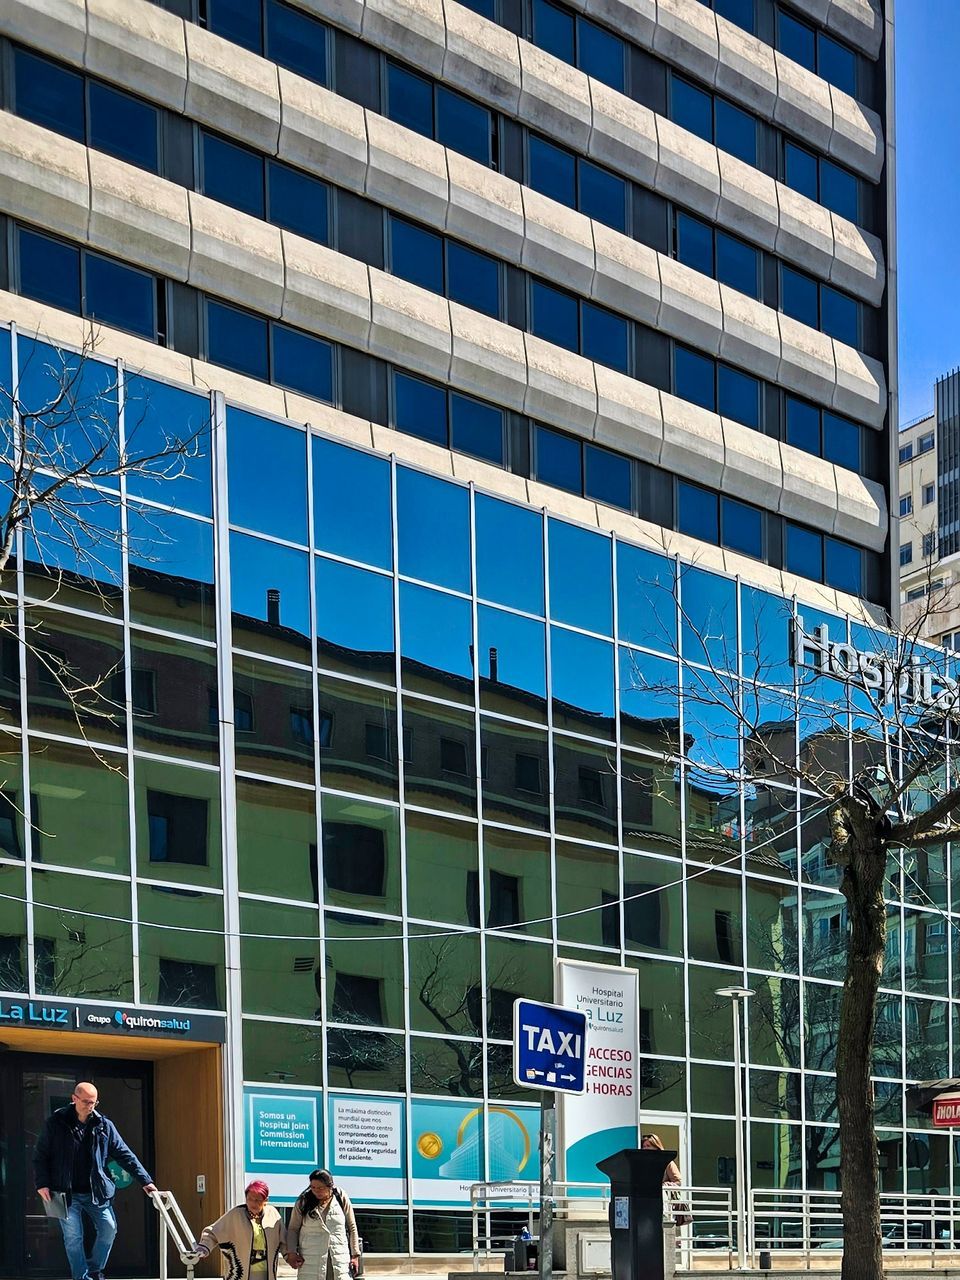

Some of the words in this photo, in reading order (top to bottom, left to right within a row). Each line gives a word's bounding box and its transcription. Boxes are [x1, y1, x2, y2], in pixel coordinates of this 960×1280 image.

[592, 986, 624, 998] Hospital
[576, 995, 624, 1008] Universitario
[0, 1002, 23, 1020] La
[29, 1002, 68, 1023] Luz
[88, 1014, 111, 1025] Grupo
[597, 1007, 624, 1024] Luz
[522, 1024, 581, 1059] TAXI
[588, 1047, 632, 1062] ACCESO
[593, 1082, 632, 1097] HORAS
[259, 1111, 285, 1120] Somos
[259, 1120, 290, 1130] hospital
[260, 1129, 305, 1140] Commission
[260, 1139, 310, 1149] International
